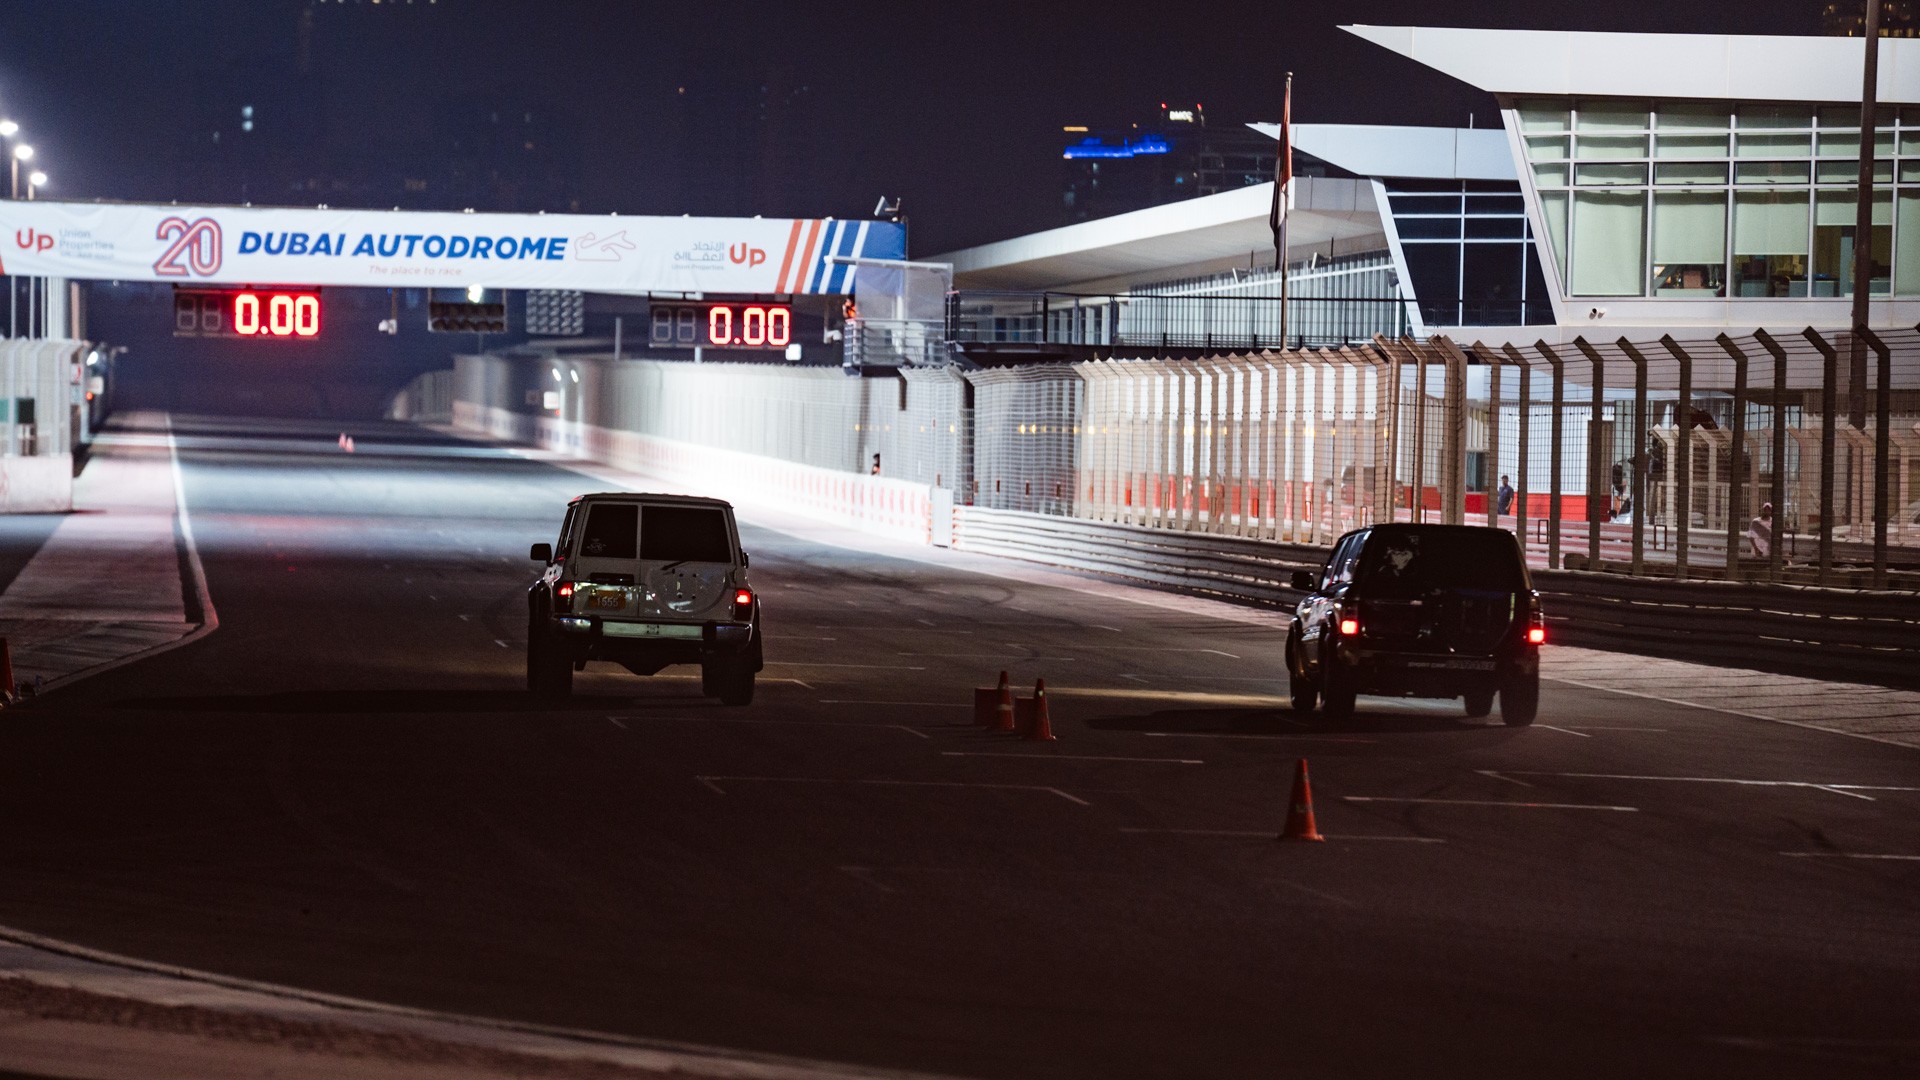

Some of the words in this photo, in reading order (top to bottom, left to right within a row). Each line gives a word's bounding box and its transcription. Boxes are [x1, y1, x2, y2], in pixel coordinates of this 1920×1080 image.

[59, 229, 91, 239] Union
[59, 239, 114, 251] Properties
[153, 216, 222, 277] 20
[238, 231, 346, 256] DUBAI
[352, 234, 568, 261] AUTODROME
[369, 265, 388, 275] The
[391, 266, 421, 276] place
[424, 267, 435, 276] to
[438, 268, 462, 276] race
[234, 293, 320, 336] 0.00
[709, 306, 790, 346] 0.00
